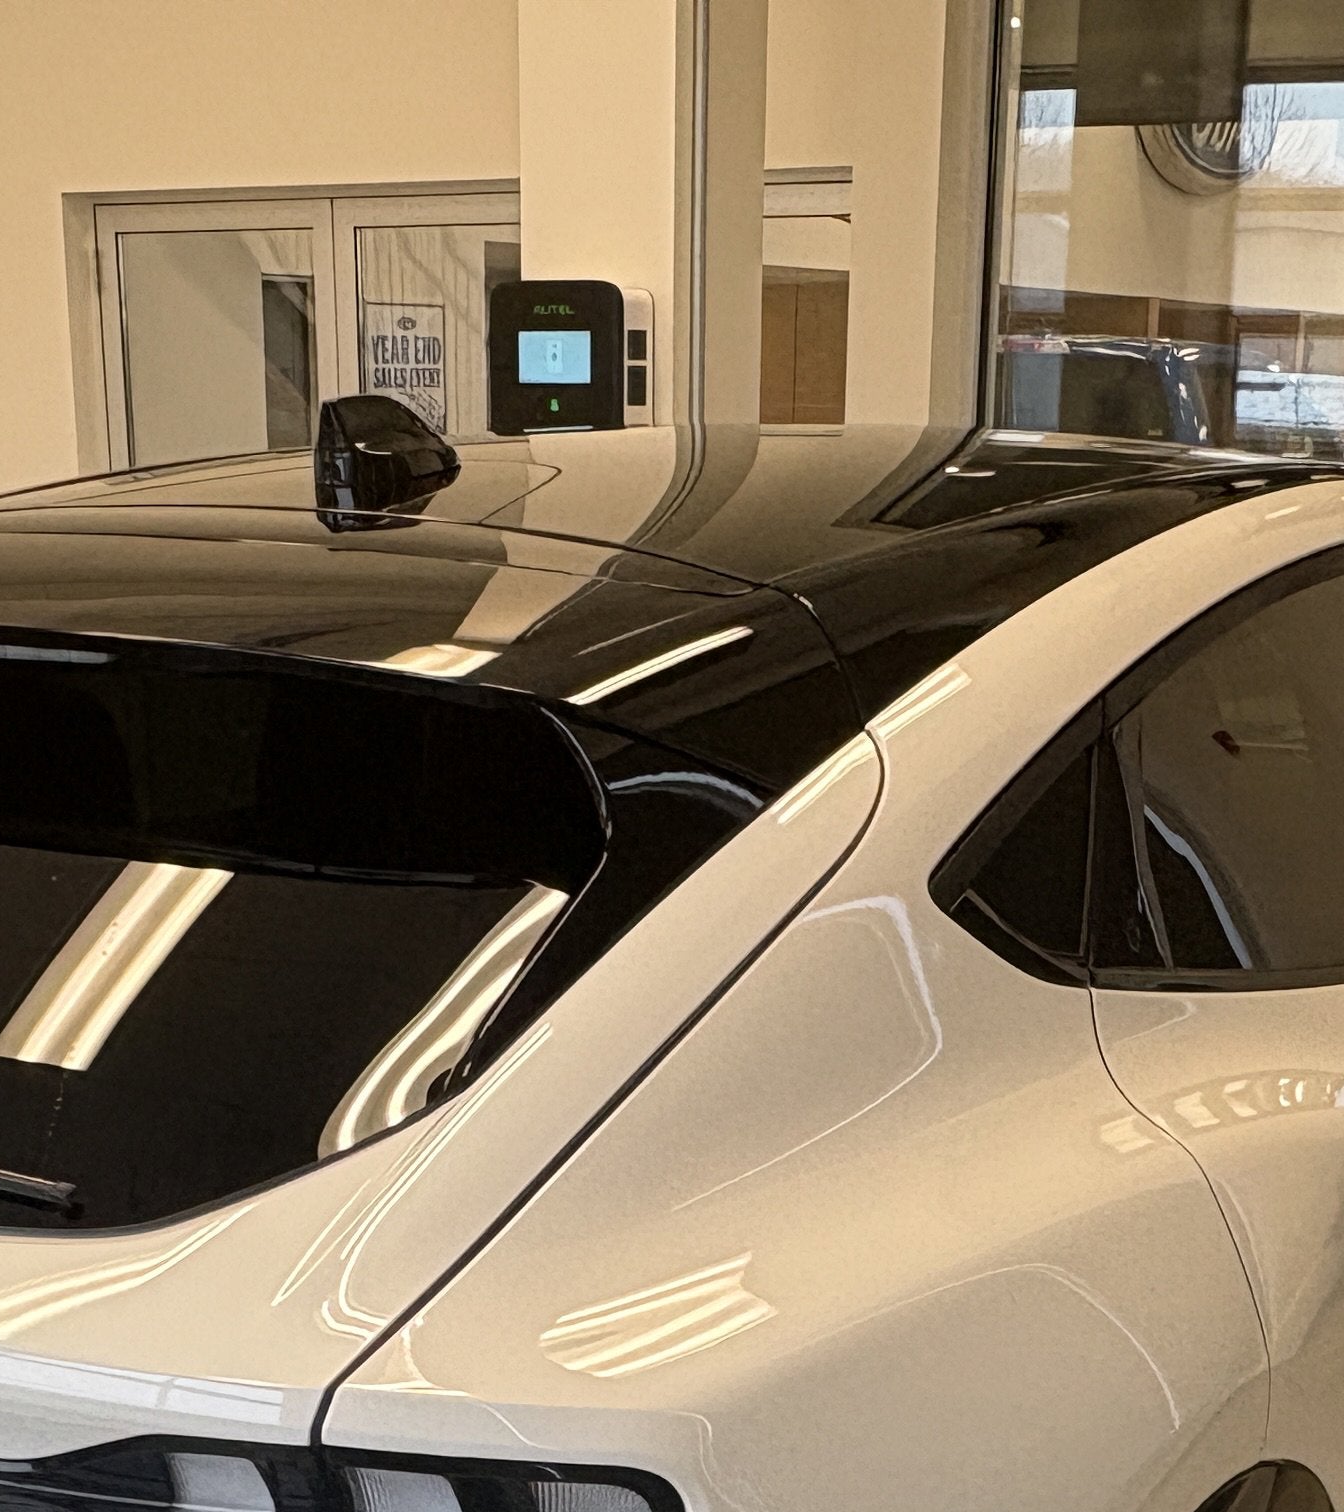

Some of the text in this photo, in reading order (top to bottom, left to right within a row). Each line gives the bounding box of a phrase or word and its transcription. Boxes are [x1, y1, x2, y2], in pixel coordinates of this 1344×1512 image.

[371, 334, 442, 365] YEAR END
[373, 367, 441, 388] SALES EVENT
